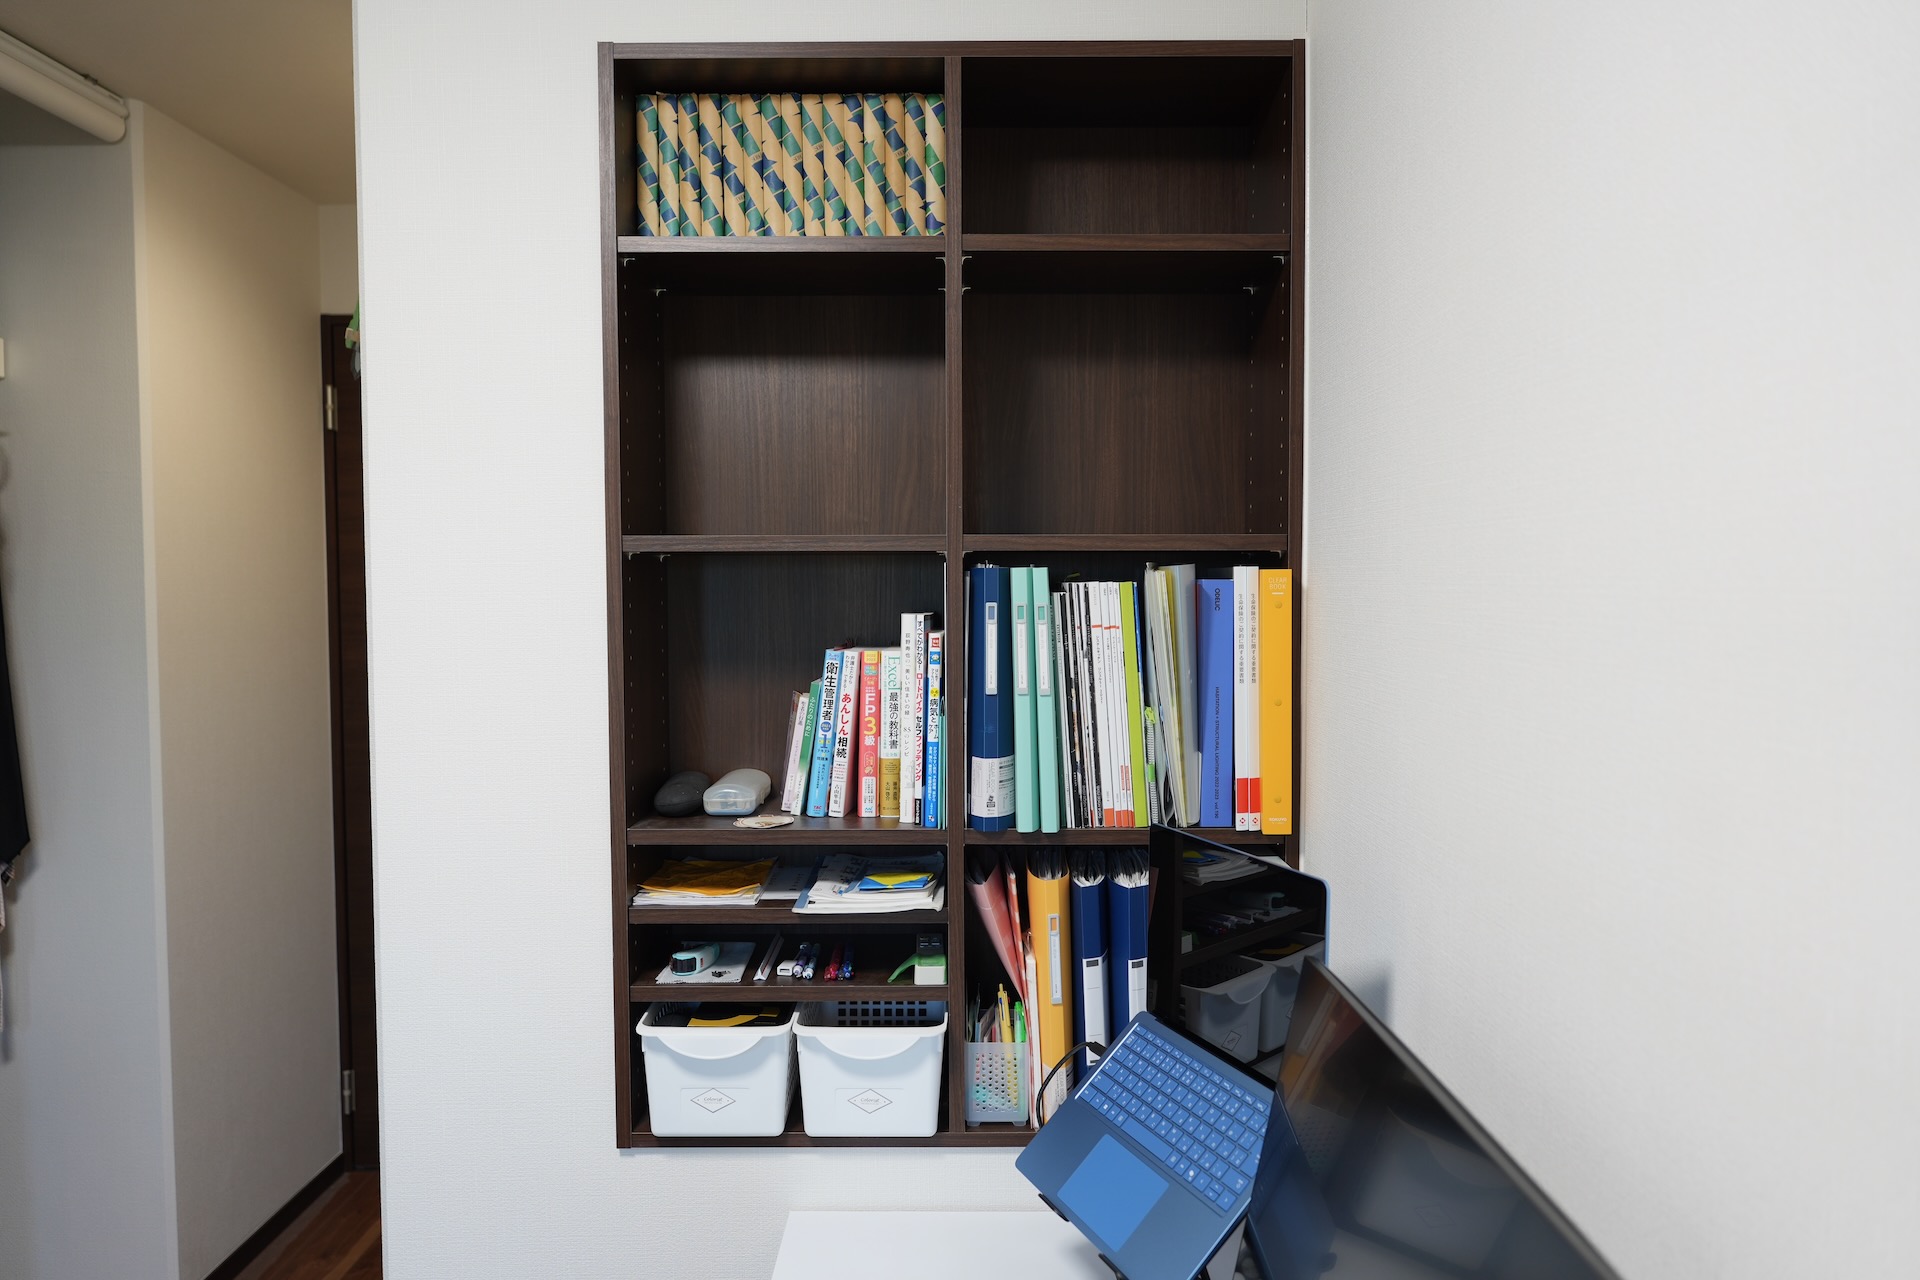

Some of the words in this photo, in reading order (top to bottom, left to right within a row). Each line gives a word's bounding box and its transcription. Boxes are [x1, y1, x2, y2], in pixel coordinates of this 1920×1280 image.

[822, 661, 839, 721] 衛生管理者
[887, 656, 901, 691] Excel
[836, 693, 852, 759] あんしん相続
[863, 693, 876, 746] FP3級
[888, 692, 899, 749] 最強の教科書
